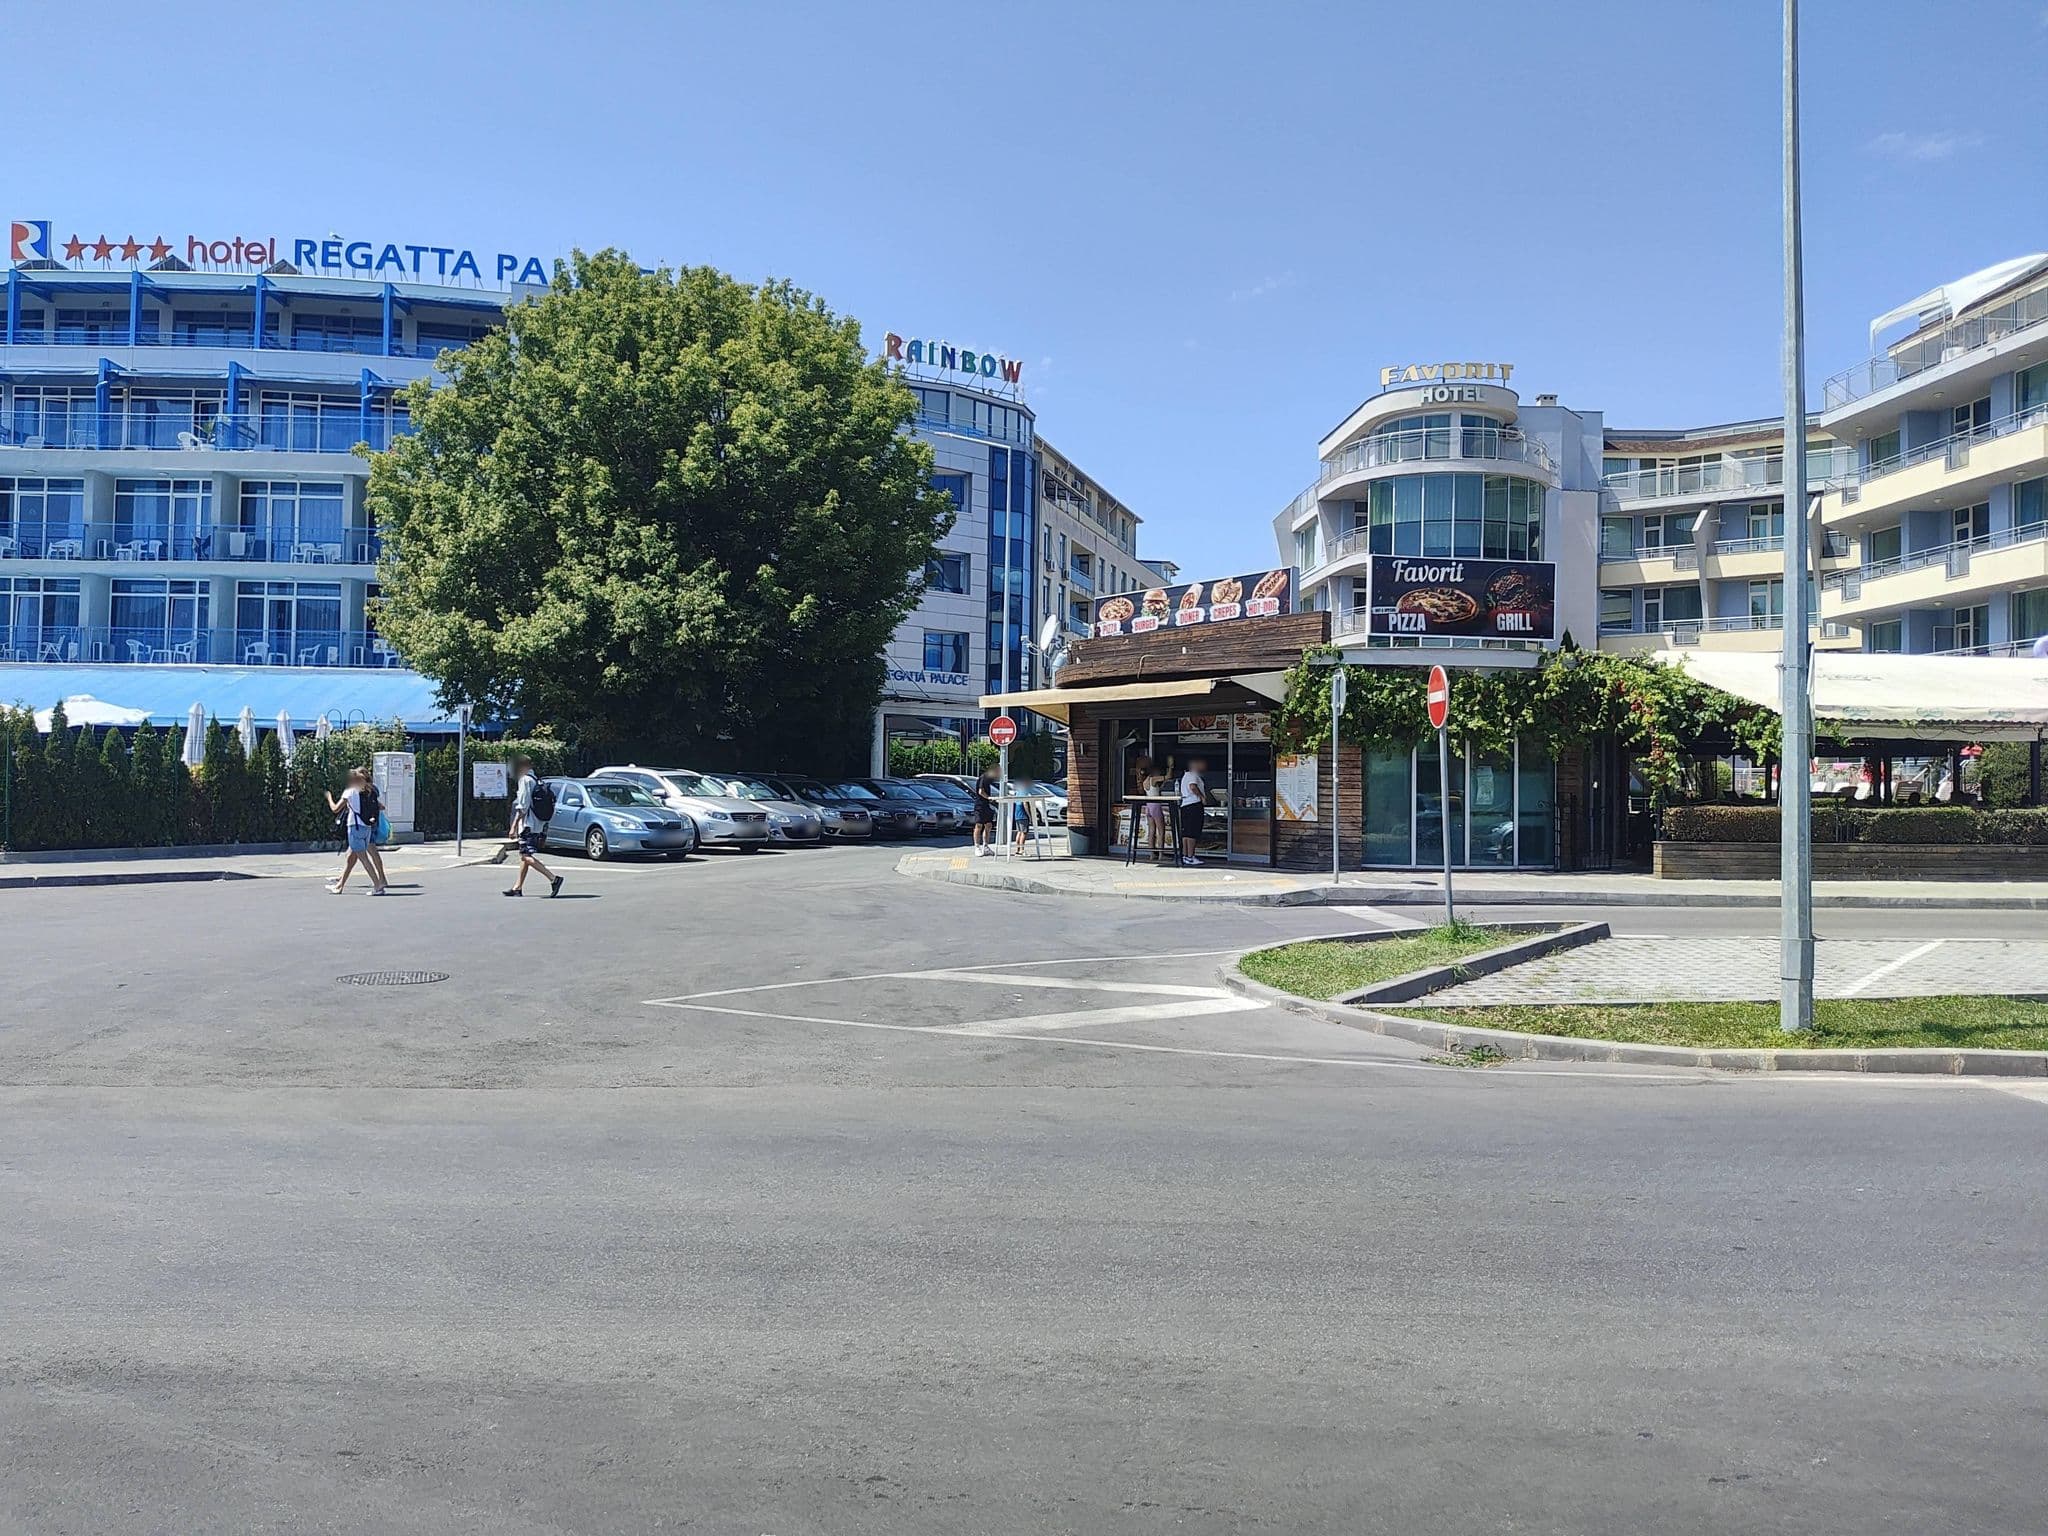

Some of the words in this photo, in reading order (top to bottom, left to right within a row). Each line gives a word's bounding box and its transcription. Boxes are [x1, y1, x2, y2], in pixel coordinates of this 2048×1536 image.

[187, 235, 276, 265] hotel
[294, 239, 482, 280] REGATTA
[885, 331, 1023, 384] RAINBOW
[1380, 362, 1514, 386] FAVORIT
[1421, 385, 1486, 404] HOTEL
[1391, 559, 1465, 583] Favorit
[1388, 612, 1427, 632] PIZZA
[1496, 612, 1534, 631] GRILL
[930, 672, 968, 686] PALACE
